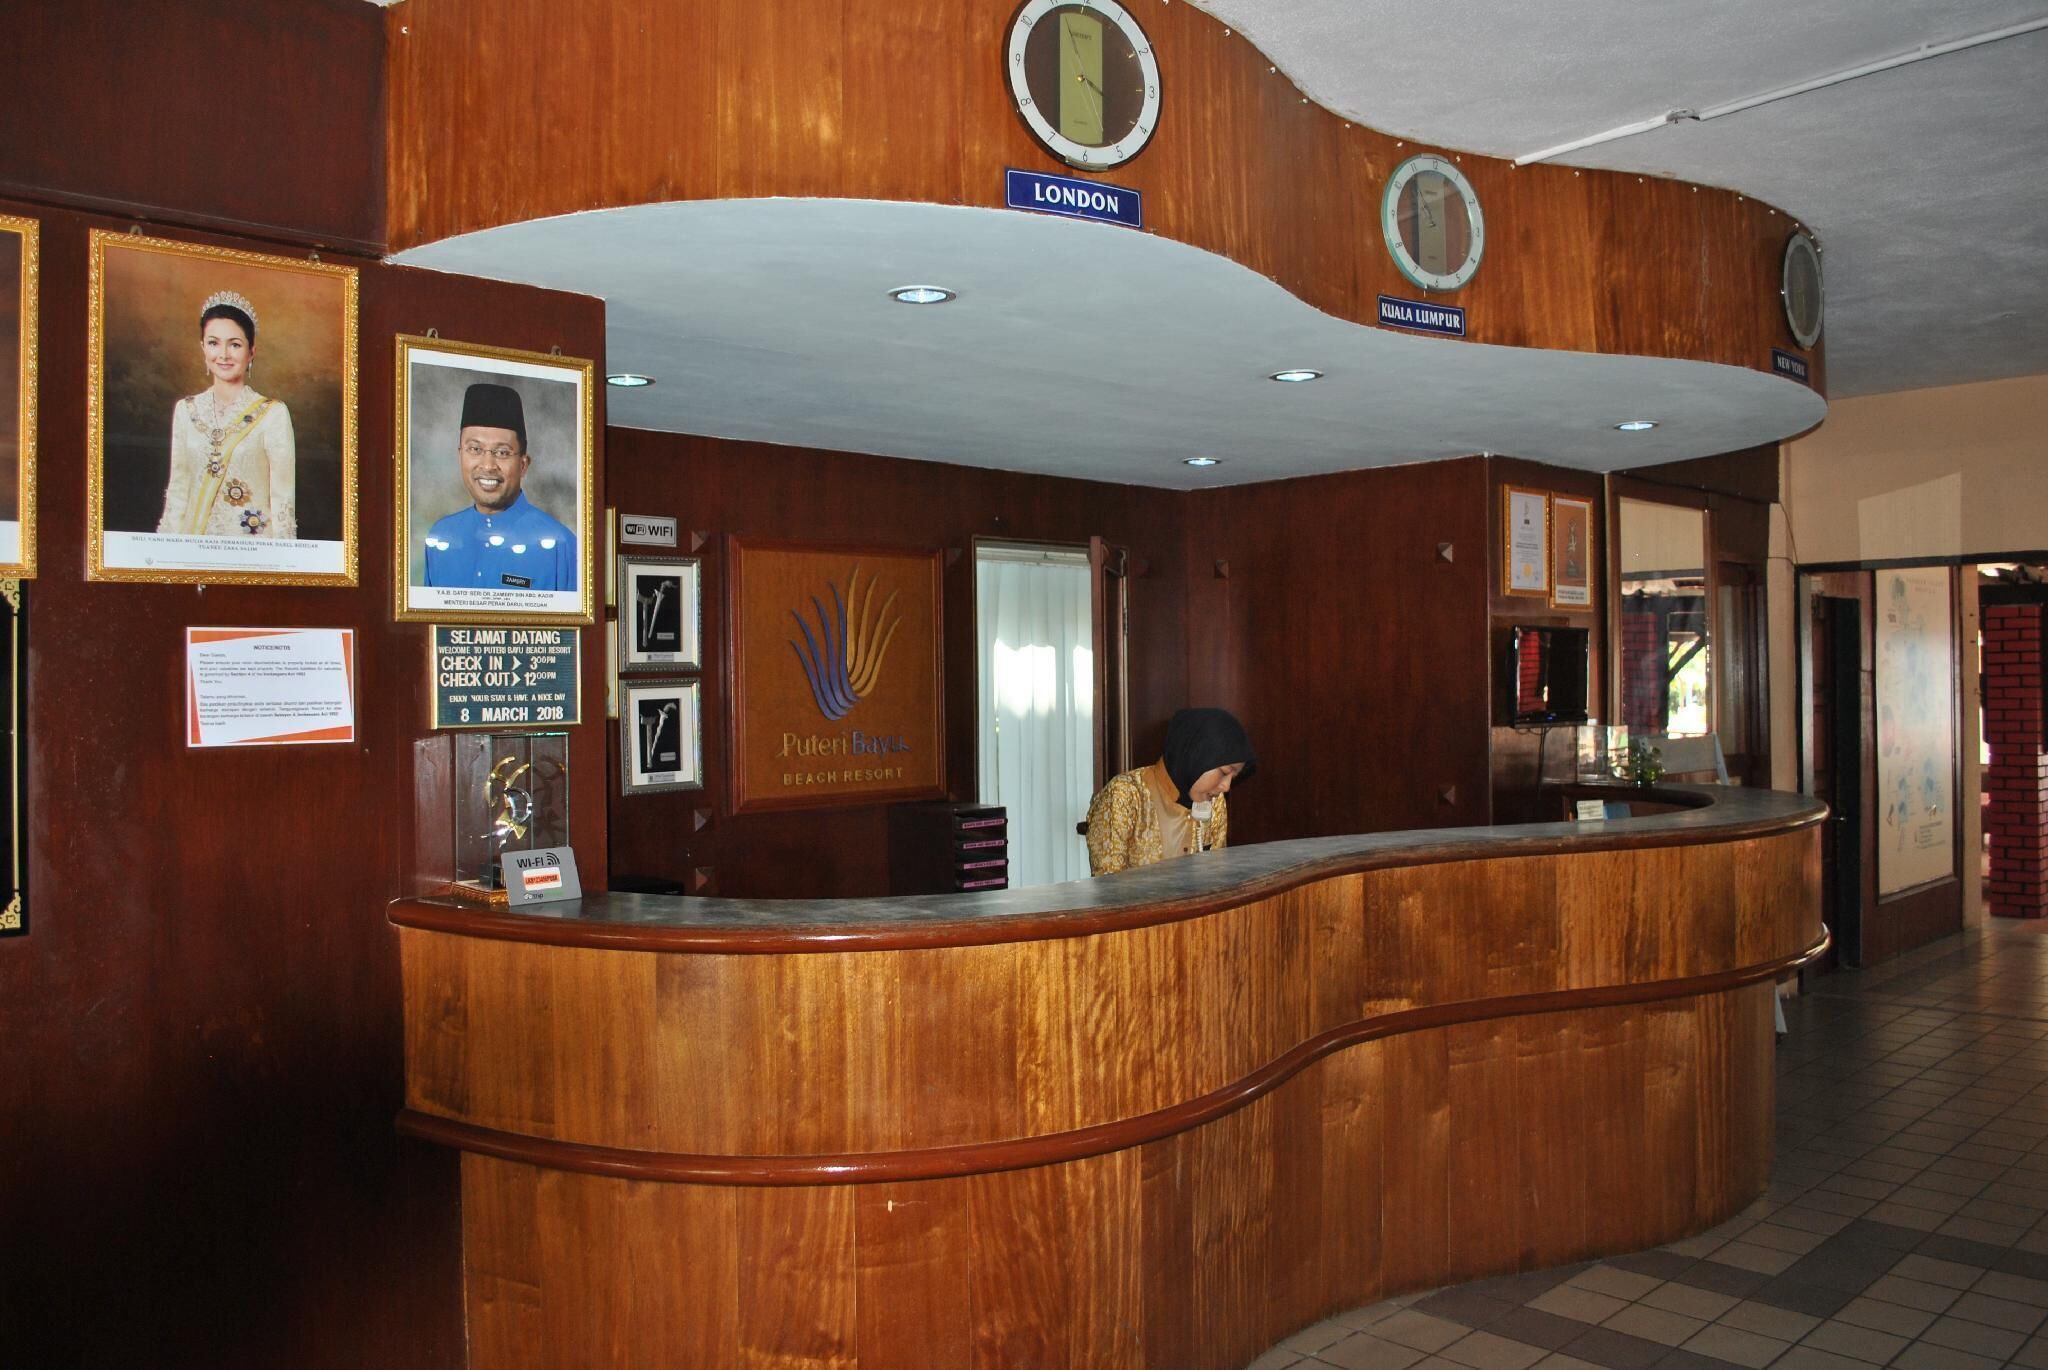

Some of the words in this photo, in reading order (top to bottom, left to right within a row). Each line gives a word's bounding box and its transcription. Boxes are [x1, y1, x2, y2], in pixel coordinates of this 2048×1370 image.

[1021, 15, 1033, 27] 10
[1138, 47, 1149, 56] 2
[1015, 53, 1021, 67] 9
[1148, 85, 1155, 99] 3
[1020, 97, 1032, 106] 8
[1047, 131, 1056, 142] 7
[1082, 150, 1088, 163] 6
[1116, 145, 1124, 158] 5
[1034, 182, 1119, 214] LONDON
[1381, 302, 1413, 322] KUALA
[1415, 309, 1461, 329] LUMPUR
[1777, 355, 1790, 371] NEW
[1791, 361, 1805, 377] YORK
[648, 525, 673, 537] WIFI
[450, 630, 507, 645] SELAMAT
[512, 631, 561, 645] DATANG
[438, 646, 471, 654] WELCOME
[473, 646, 482, 654] TO
[483, 646, 507, 654] PUTERI
[507, 646, 524, 654] BAYU
[525, 646, 547, 654] BEACH
[548, 646, 571, 655] RESORT
[441, 655, 483, 671] CHECK
[489, 655, 503, 671] IN
[440, 672, 482, 688] CHECK
[484, 672, 510, 687] OUT
[449, 695, 468, 703] ENJOY
[470, 694, 489, 702] YOUR
[490, 694, 506, 702] STAY
[507, 694, 512, 702] &
[513, 693, 529, 701] HAVE
[531, 693, 536, 701] A
[537, 693, 553, 701] NICE
[554, 693, 566, 701] DAY
[460, 708, 470, 722] 8
[481, 706, 529, 722] MARCH
[536, 706, 564, 721] 2018
[778, 732, 847, 757] Puteri
[852, 730, 911, 760] Bayu
[783, 769, 837, 786] BEACH
[843, 766, 904, 783] RESORT
[516, 856, 544, 868] WI-FI
